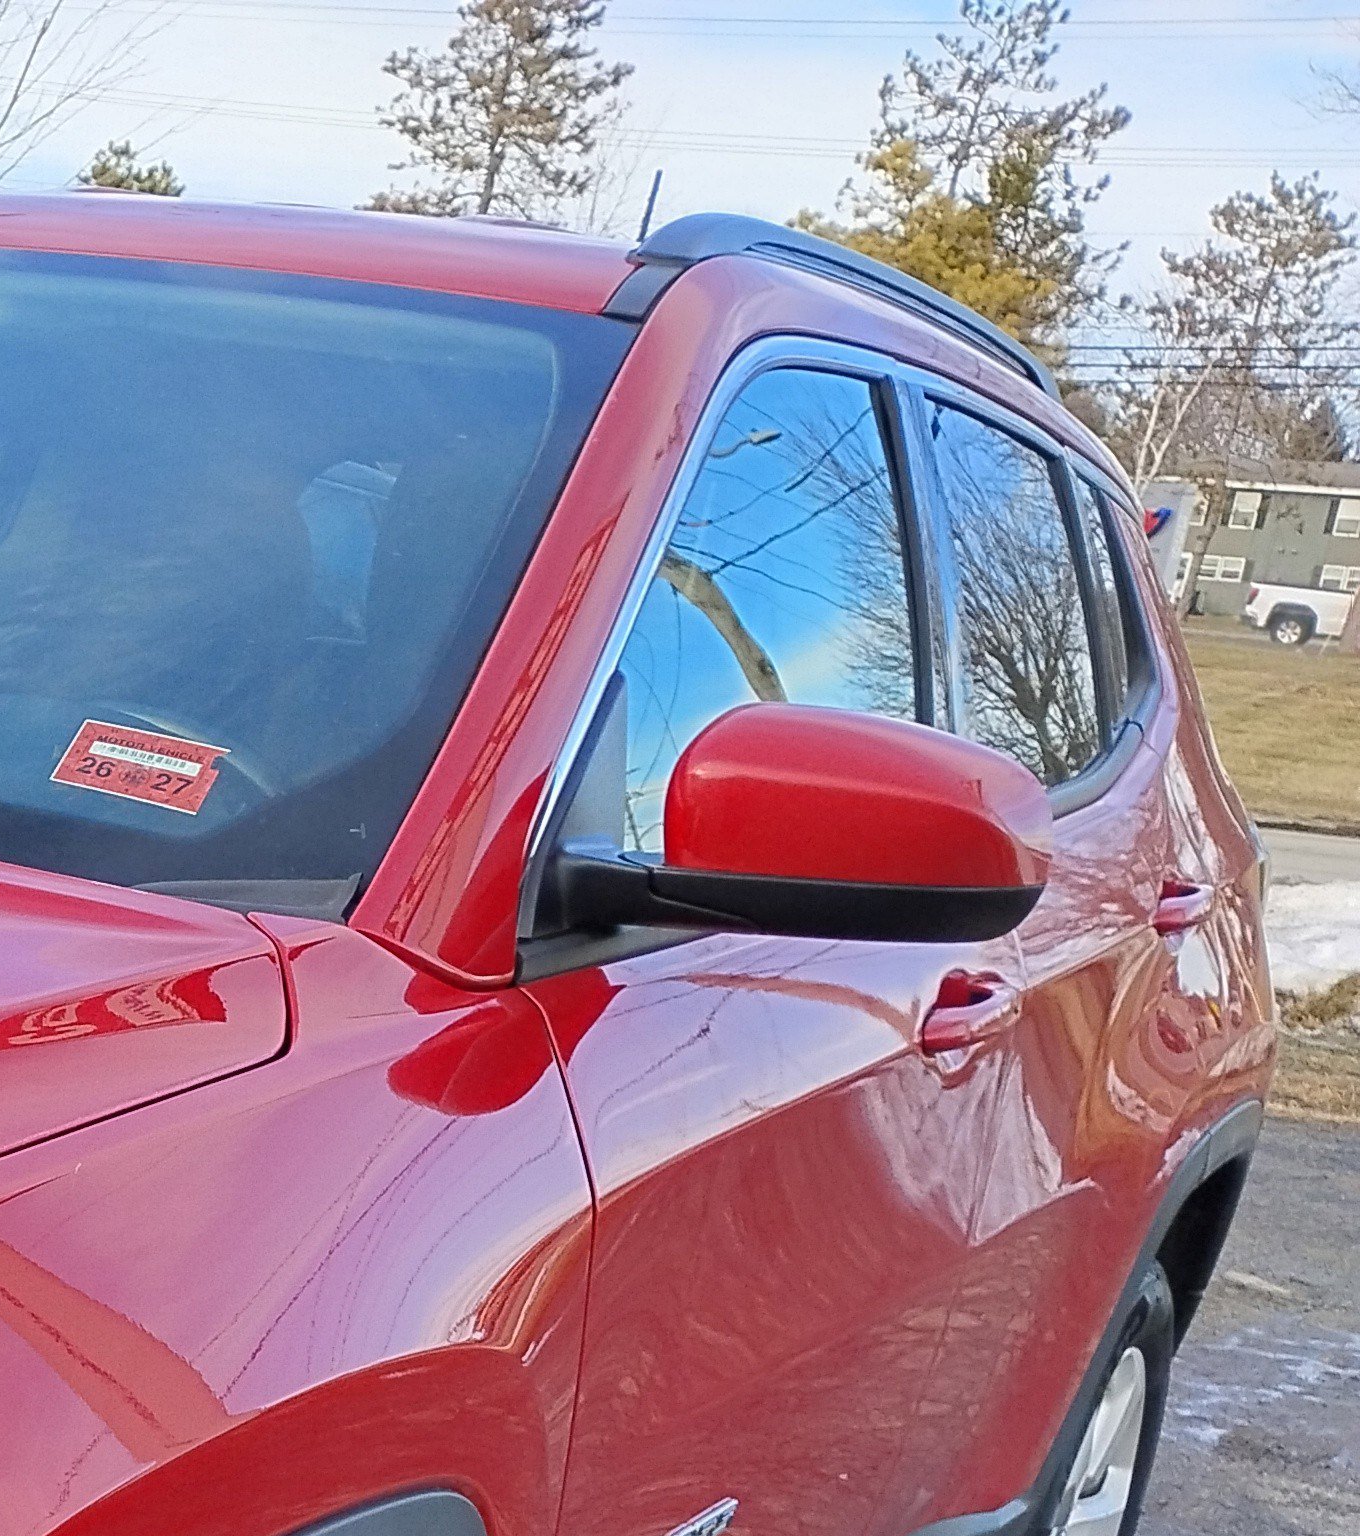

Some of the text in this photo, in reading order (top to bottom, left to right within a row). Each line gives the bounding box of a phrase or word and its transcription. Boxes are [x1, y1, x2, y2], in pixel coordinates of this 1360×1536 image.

[97, 734, 146, 751] MOTOR
[147, 743, 206, 763] VEHICLE
[76, 756, 116, 779] 26
[150, 772, 194, 797] 27
